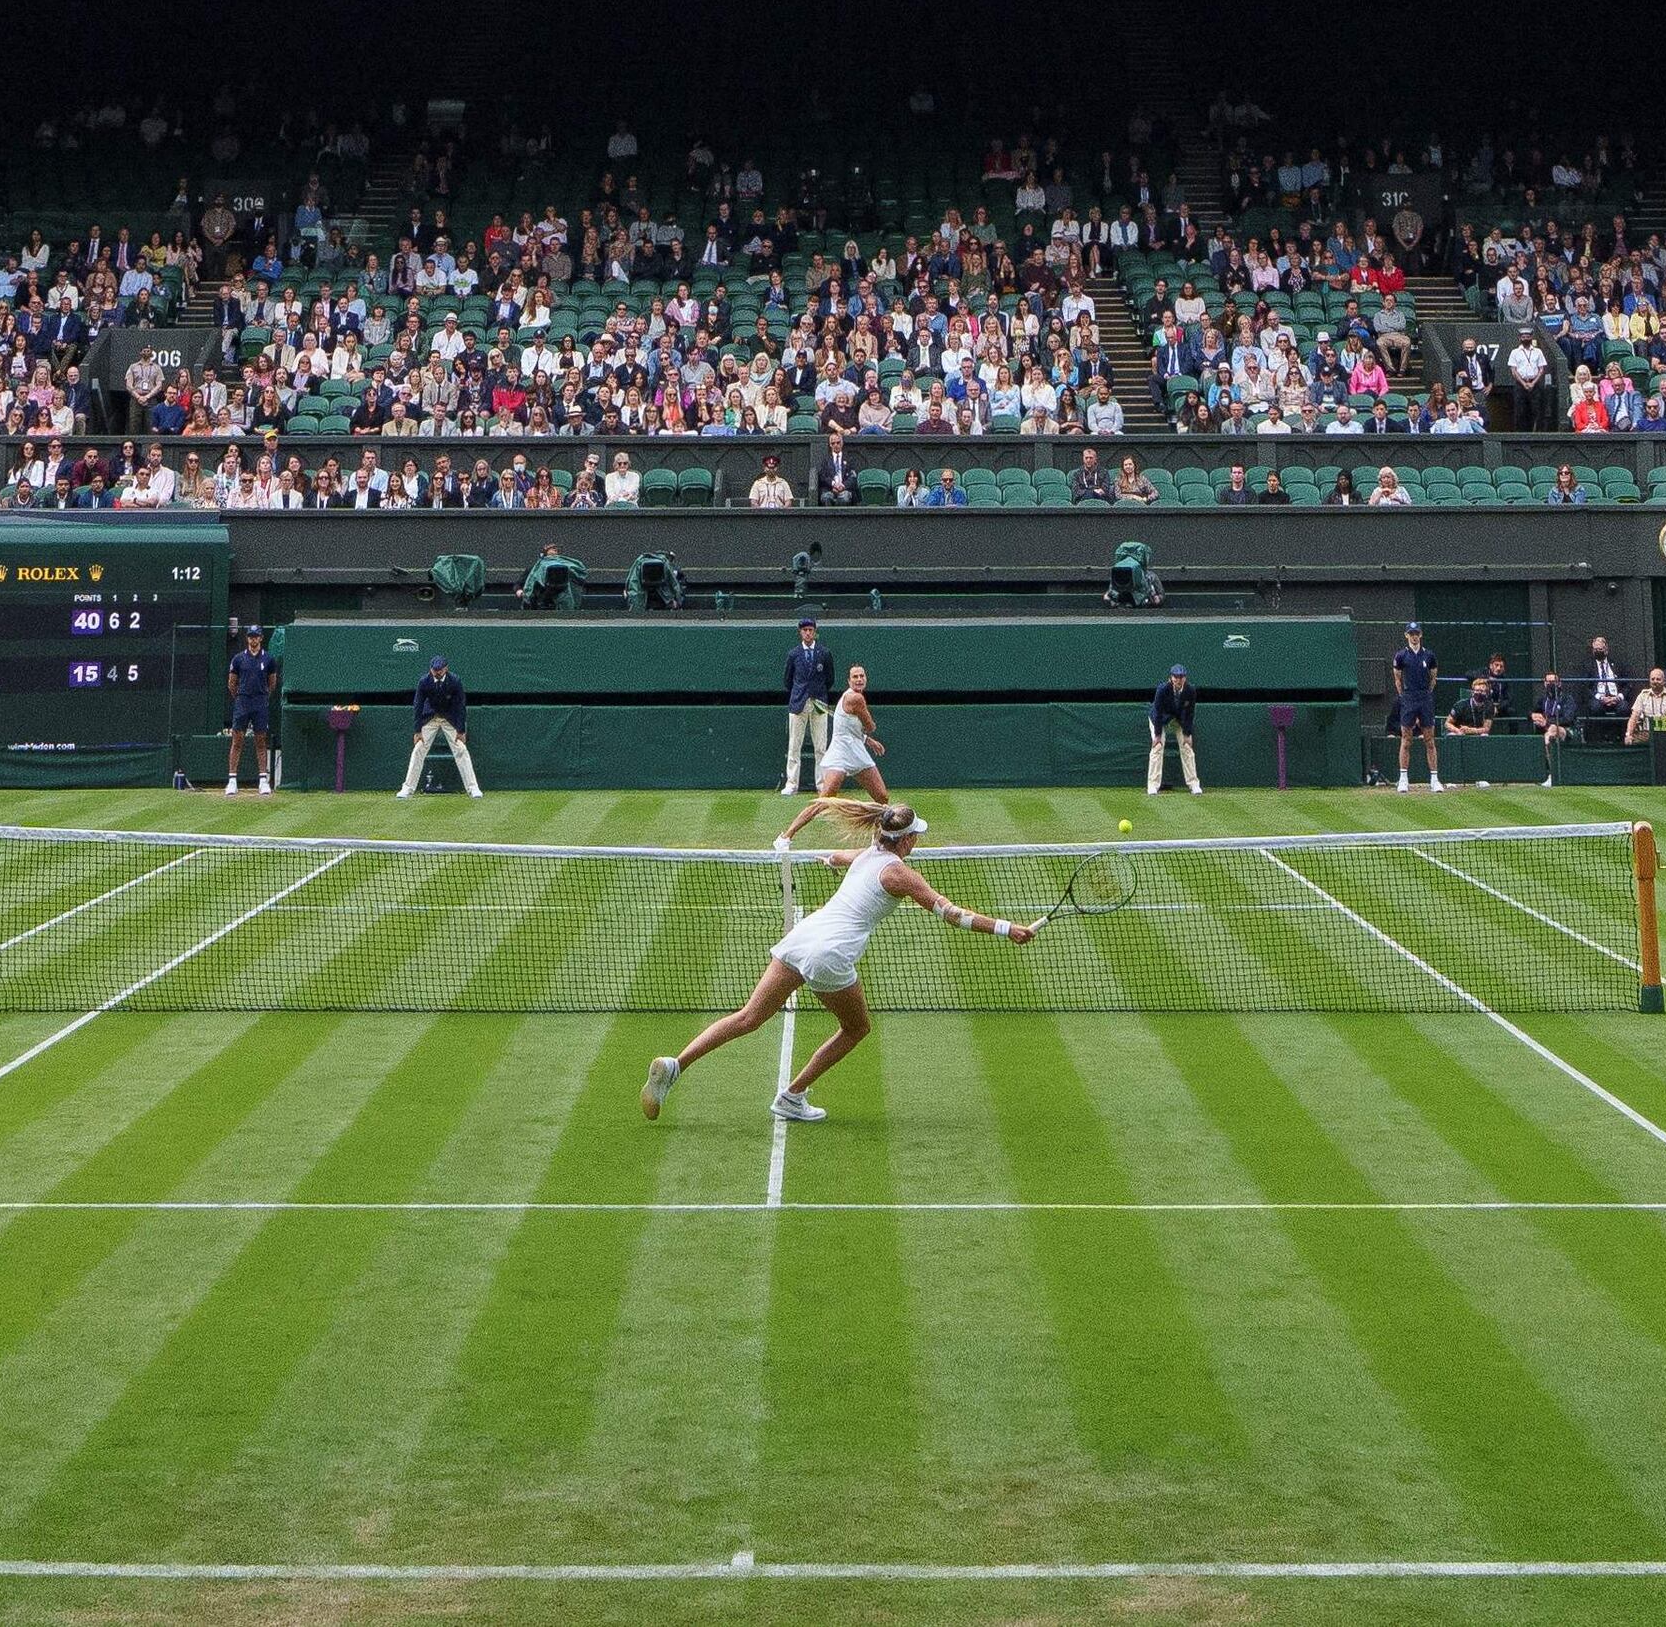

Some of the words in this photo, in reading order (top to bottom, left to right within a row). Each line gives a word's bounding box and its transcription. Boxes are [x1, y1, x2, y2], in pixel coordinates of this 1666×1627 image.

[17, 567, 80, 581] ROLEX
[172, 566, 201, 580] 1:12
[74, 594, 102, 602] POINTS
[74, 612, 101, 630] 40
[109, 612, 120, 629] 6
[129, 612, 141, 629] 2
[72, 665, 99, 682] 15
[107, 665, 118, 681] 4
[128, 665, 139, 681] 5
